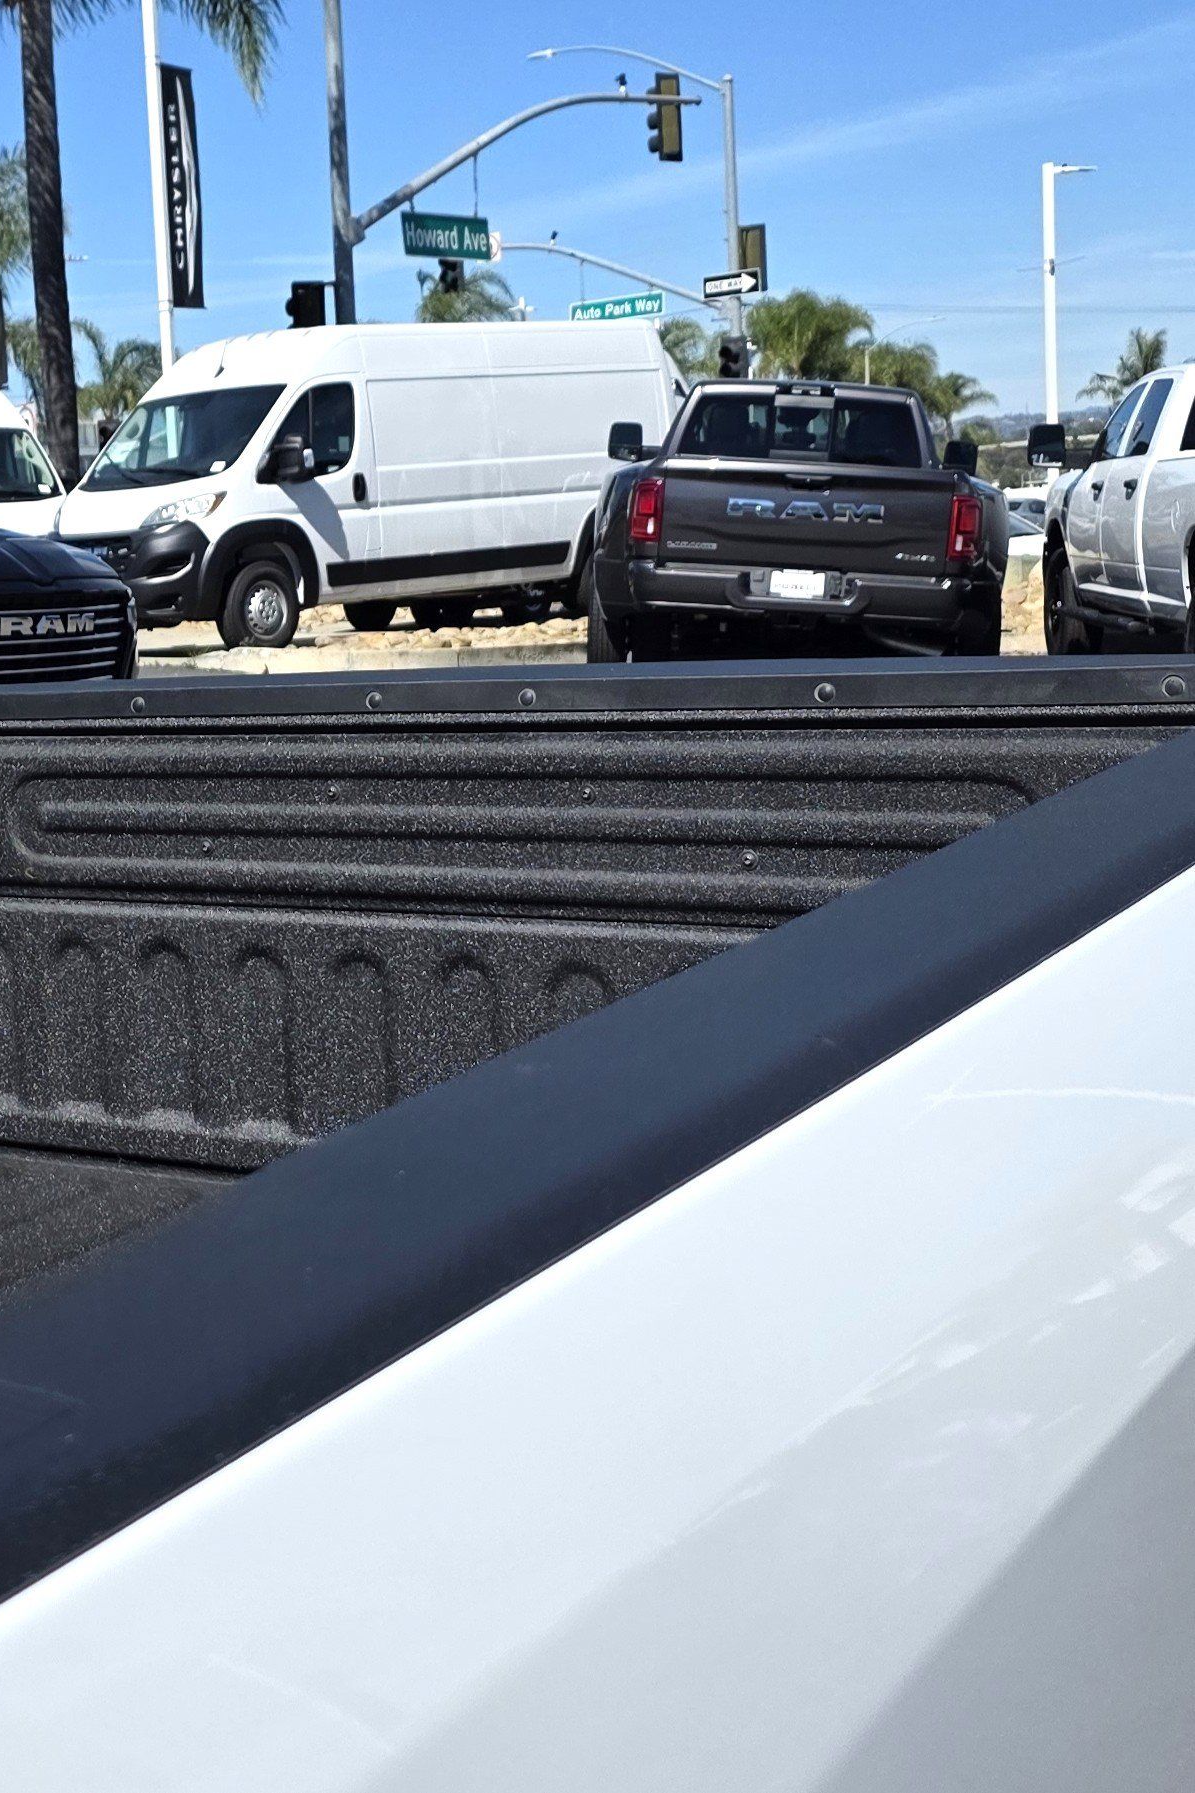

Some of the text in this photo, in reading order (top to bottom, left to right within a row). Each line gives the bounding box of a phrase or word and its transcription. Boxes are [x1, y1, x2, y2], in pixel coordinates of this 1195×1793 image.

[167, 103, 184, 270] CHRYSLER
[405, 221, 488, 252] Howard Ave
[574, 298, 660, 321] Auto Park Way
[726, 498, 885, 523] RAM
[0, 612, 95, 636] RAM
